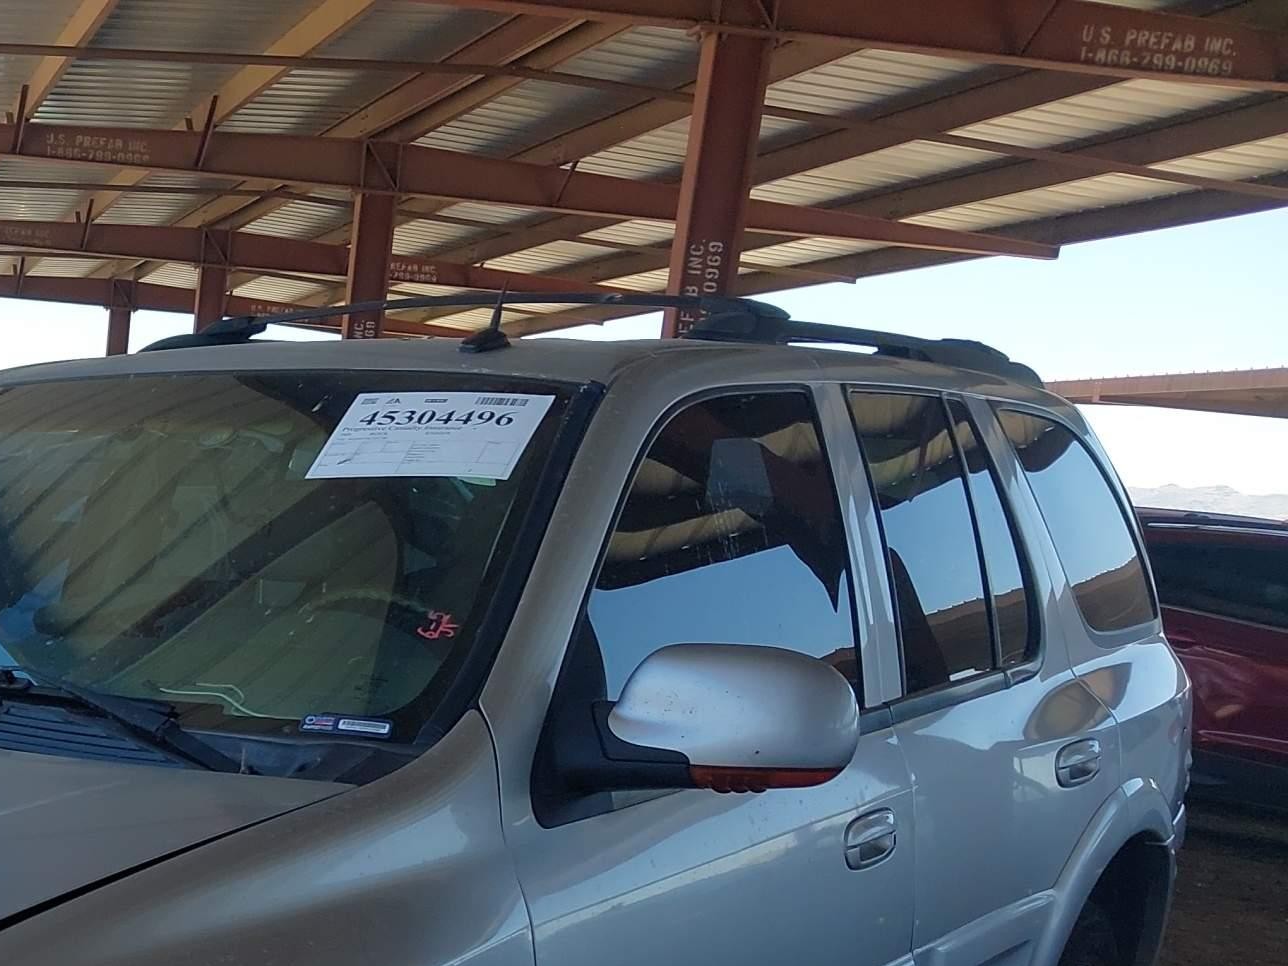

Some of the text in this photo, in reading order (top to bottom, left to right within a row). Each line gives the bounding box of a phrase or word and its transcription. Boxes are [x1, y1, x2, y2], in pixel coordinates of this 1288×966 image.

[1124, 29, 1196, 51] PREFAB
[1204, 36, 1237, 56] INC.
[688, 240, 706, 275] INC.
[703, 241, 724, 293] 0969
[359, 410, 520, 426] 45304496
